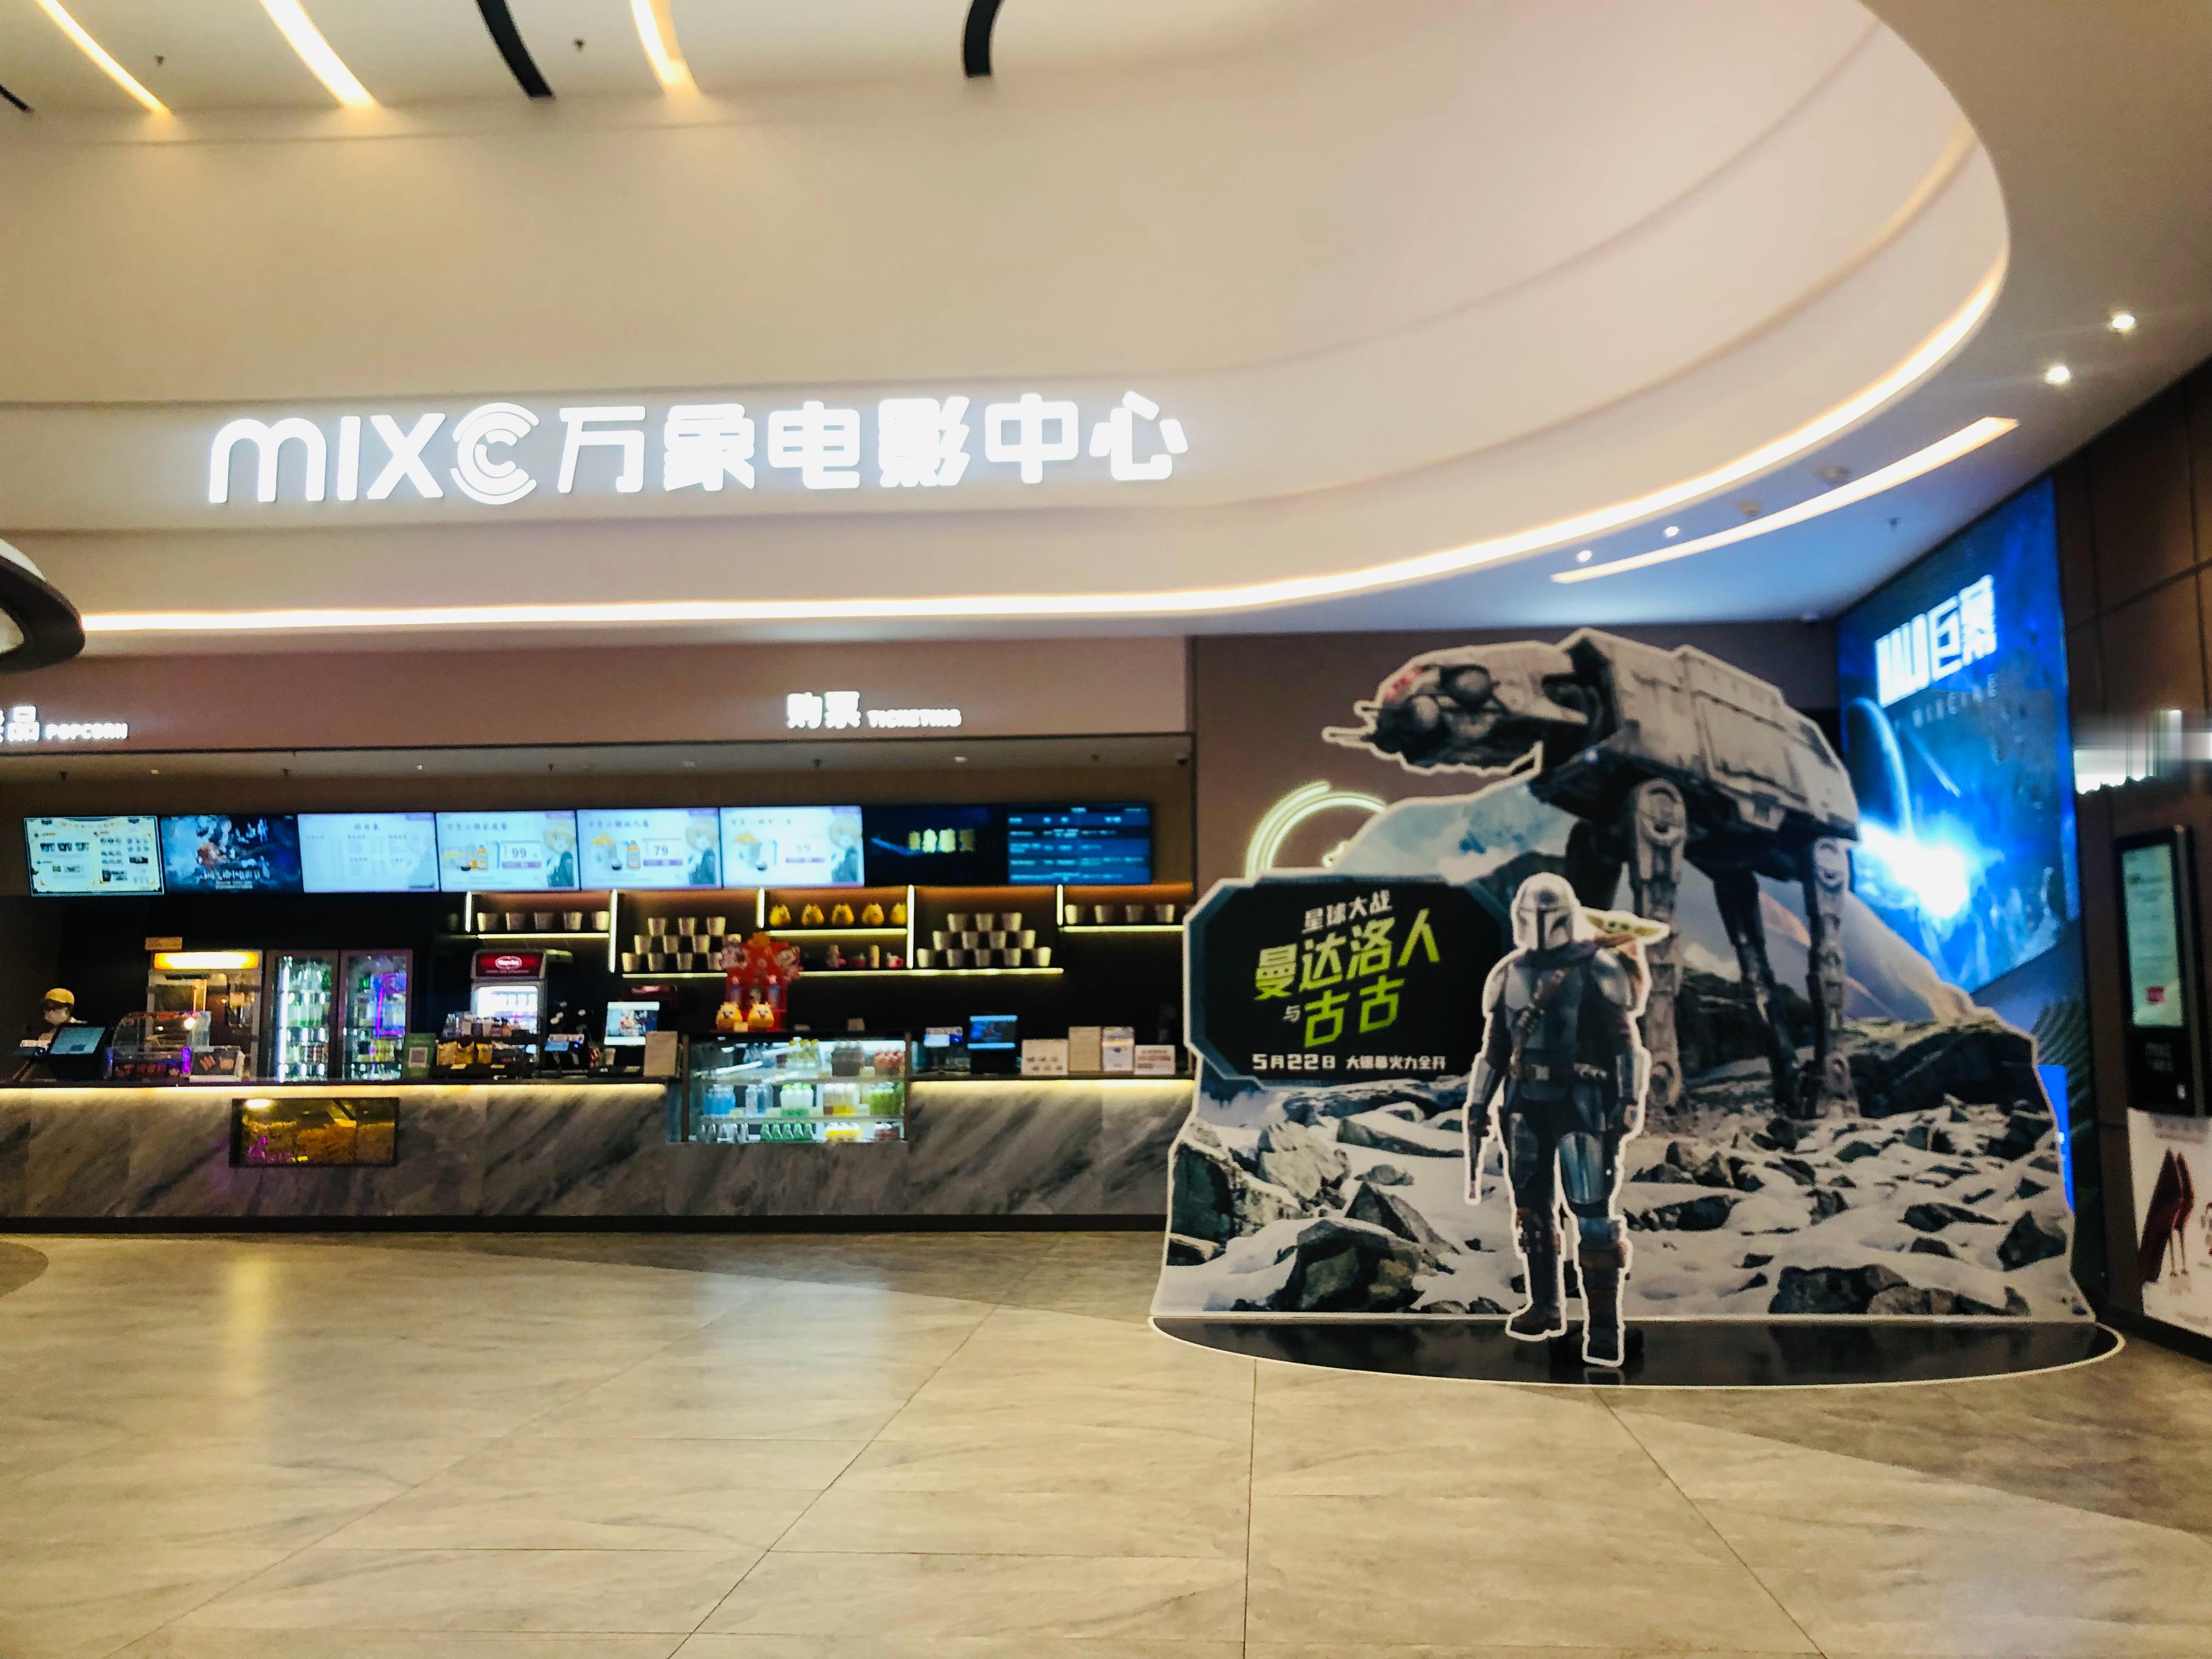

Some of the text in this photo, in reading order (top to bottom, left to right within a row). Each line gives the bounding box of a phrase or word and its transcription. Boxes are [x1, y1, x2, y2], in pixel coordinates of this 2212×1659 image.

[557, 390, 1189, 493] 万象电影中心
[0, 706, 128, 742] 品 POPCORN
[512, 847, 527, 859] 99
[1301, 889, 1393, 934] 星球大战
[1254, 908, 1441, 1001] 曼达洛人
[1252, 1053, 1336, 1070] 5月22日
